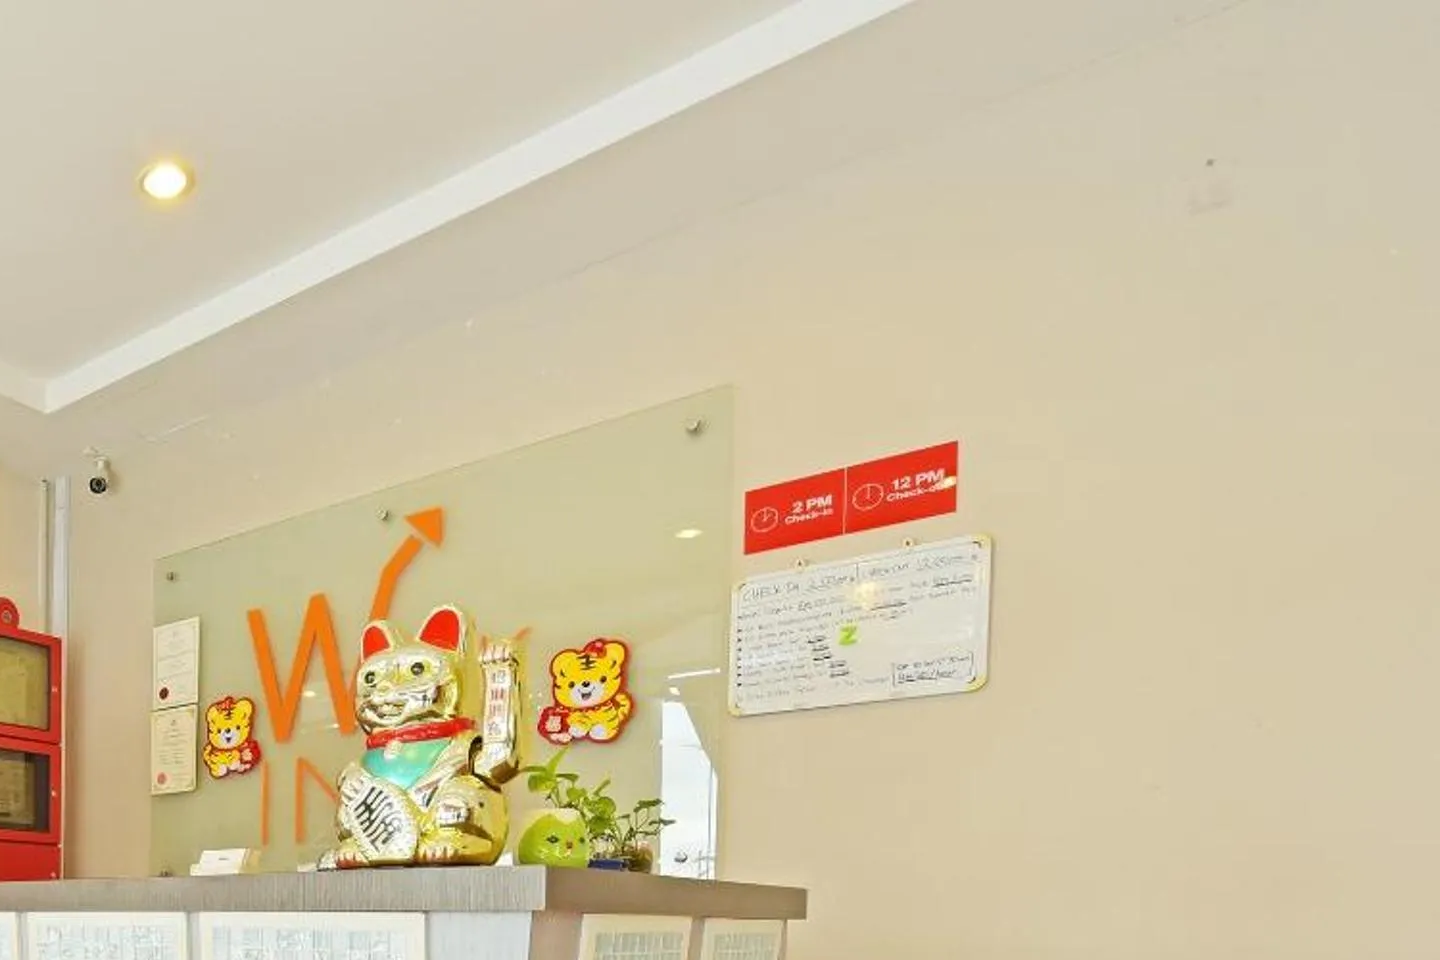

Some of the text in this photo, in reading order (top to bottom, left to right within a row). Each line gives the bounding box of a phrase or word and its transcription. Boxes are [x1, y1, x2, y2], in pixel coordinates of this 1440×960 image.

[891, 468, 945, 490] 12 PM
[886, 479, 951, 502] Check-ou
[791, 494, 833, 514] 2 PM
